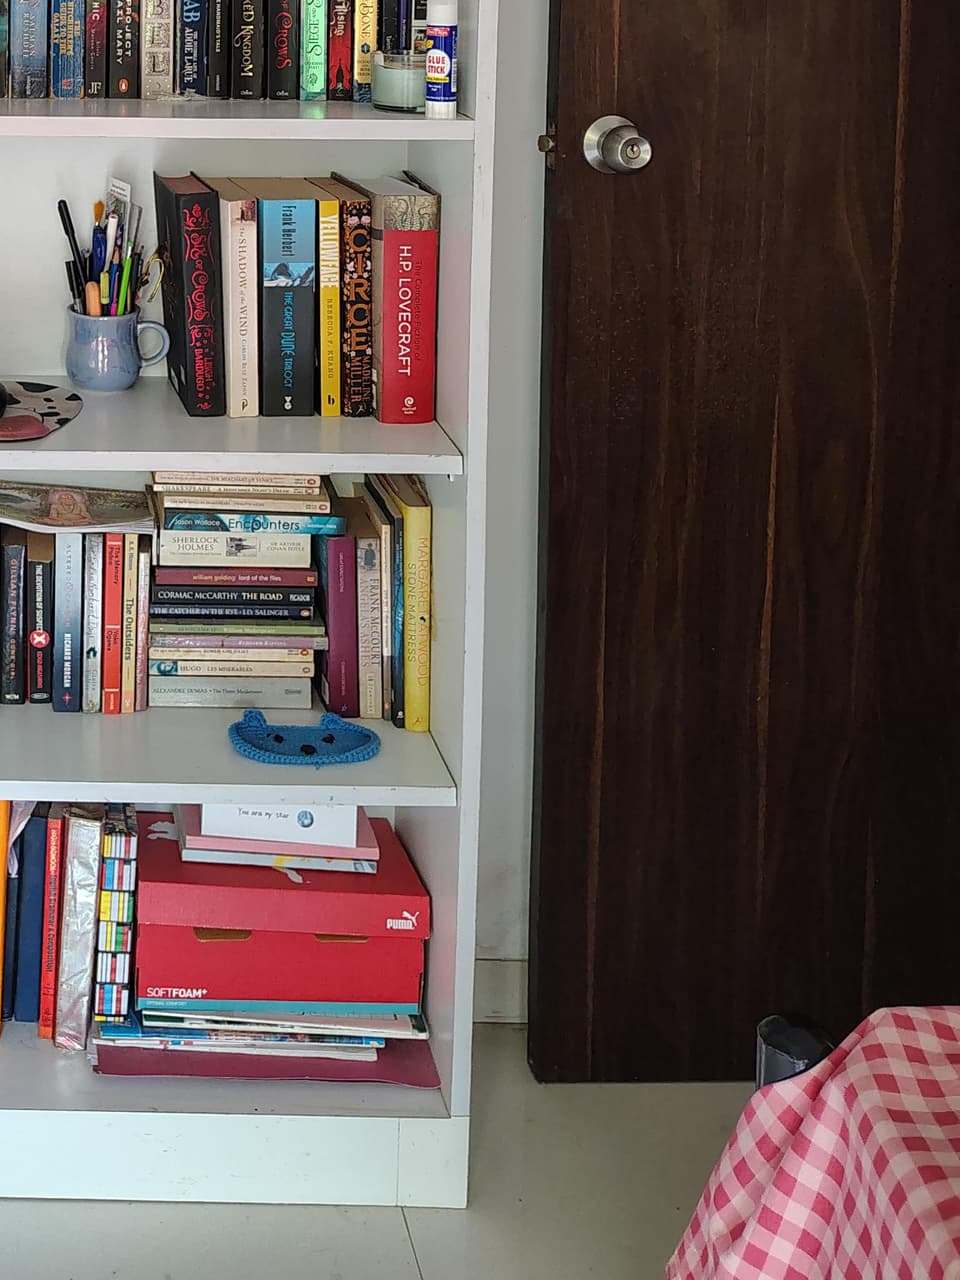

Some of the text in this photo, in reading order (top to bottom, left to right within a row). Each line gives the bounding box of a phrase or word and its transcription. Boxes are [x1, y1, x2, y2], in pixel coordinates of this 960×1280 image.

[116, 28, 124, 65] MARY
[124, 0, 132, 57] PROJECT
[234, 25, 255, 77] KINGDOM
[427, 55, 445, 65] GLUE
[427, 64, 445, 74] STICK
[280, 204, 297, 258] Frank Herbert
[320, 214, 338, 288] YELLOWFACE
[397, 245, 412, 377] H.P. LOVECRAFT
[177, 543, 214, 551] HOLMES
[228, 519, 300, 532] Encounters
[158, 591, 193, 599] CORMAC
[195, 592, 238, 600] McCARTHY
[407, 563, 416, 663] STONE MATTRESS
[124, 598, 134, 660] The Outsiders
[387, 919, 414, 930] PUMA
